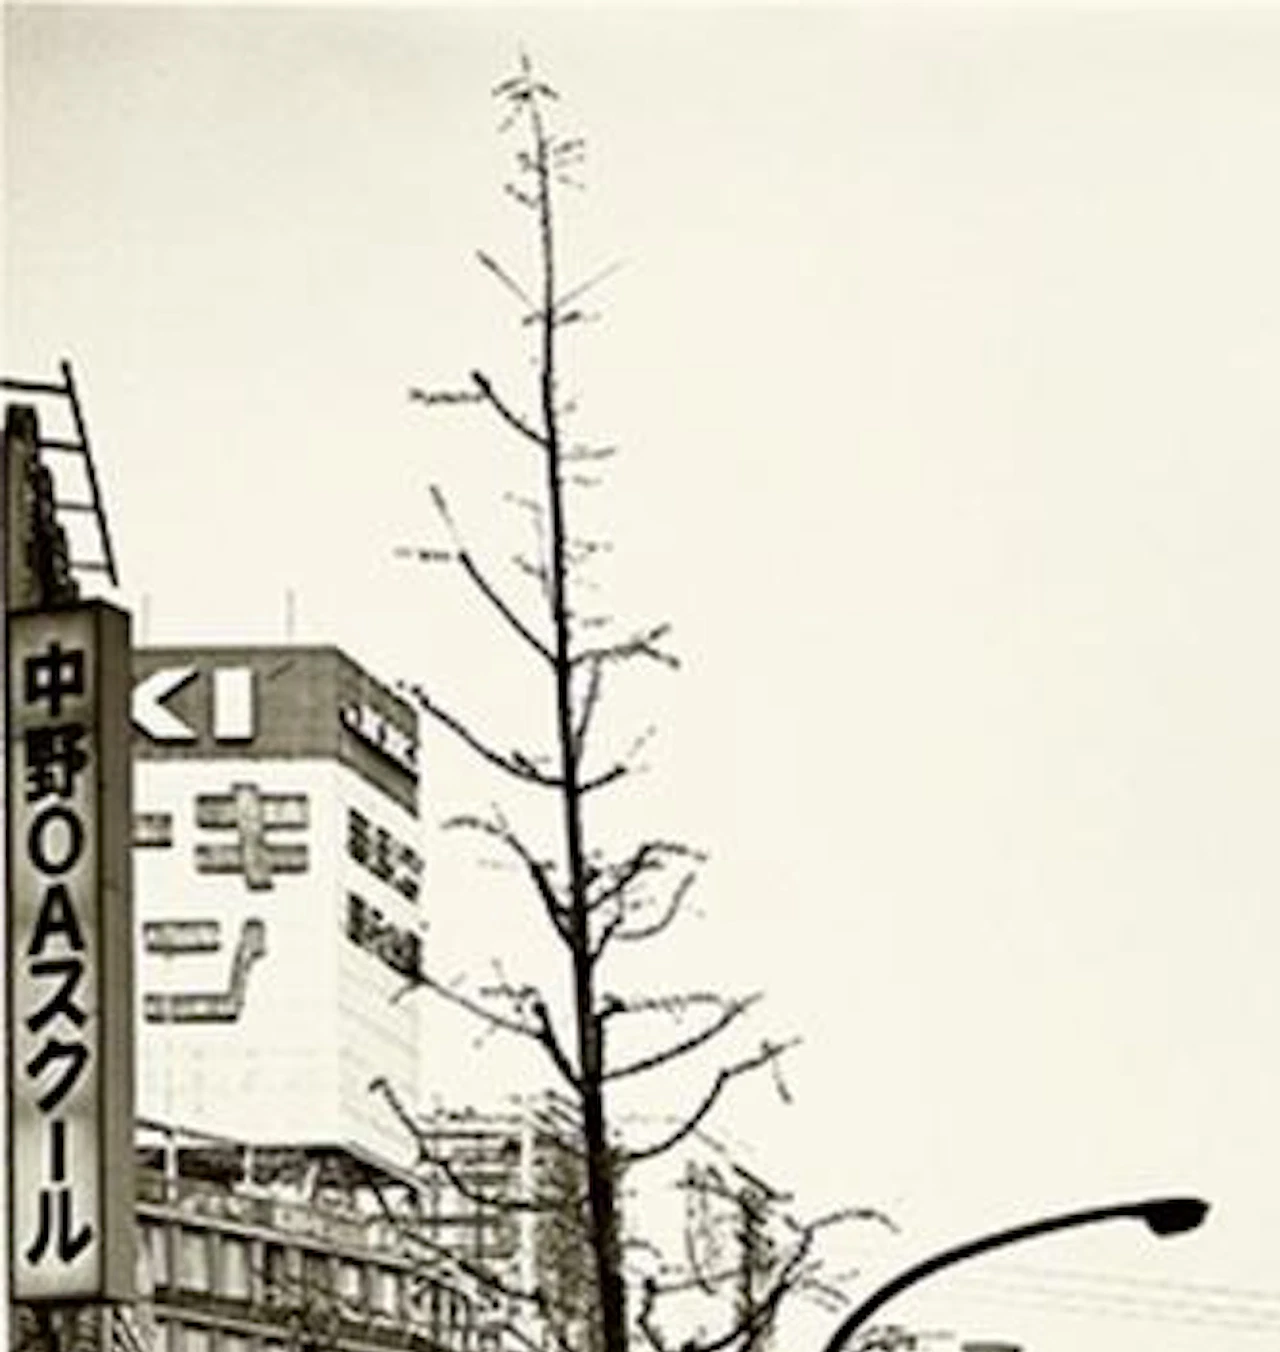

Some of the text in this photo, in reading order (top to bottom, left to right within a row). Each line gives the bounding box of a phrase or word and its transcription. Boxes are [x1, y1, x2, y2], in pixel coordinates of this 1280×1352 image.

[25, 641, 92, 1267] 中野OAスクール
